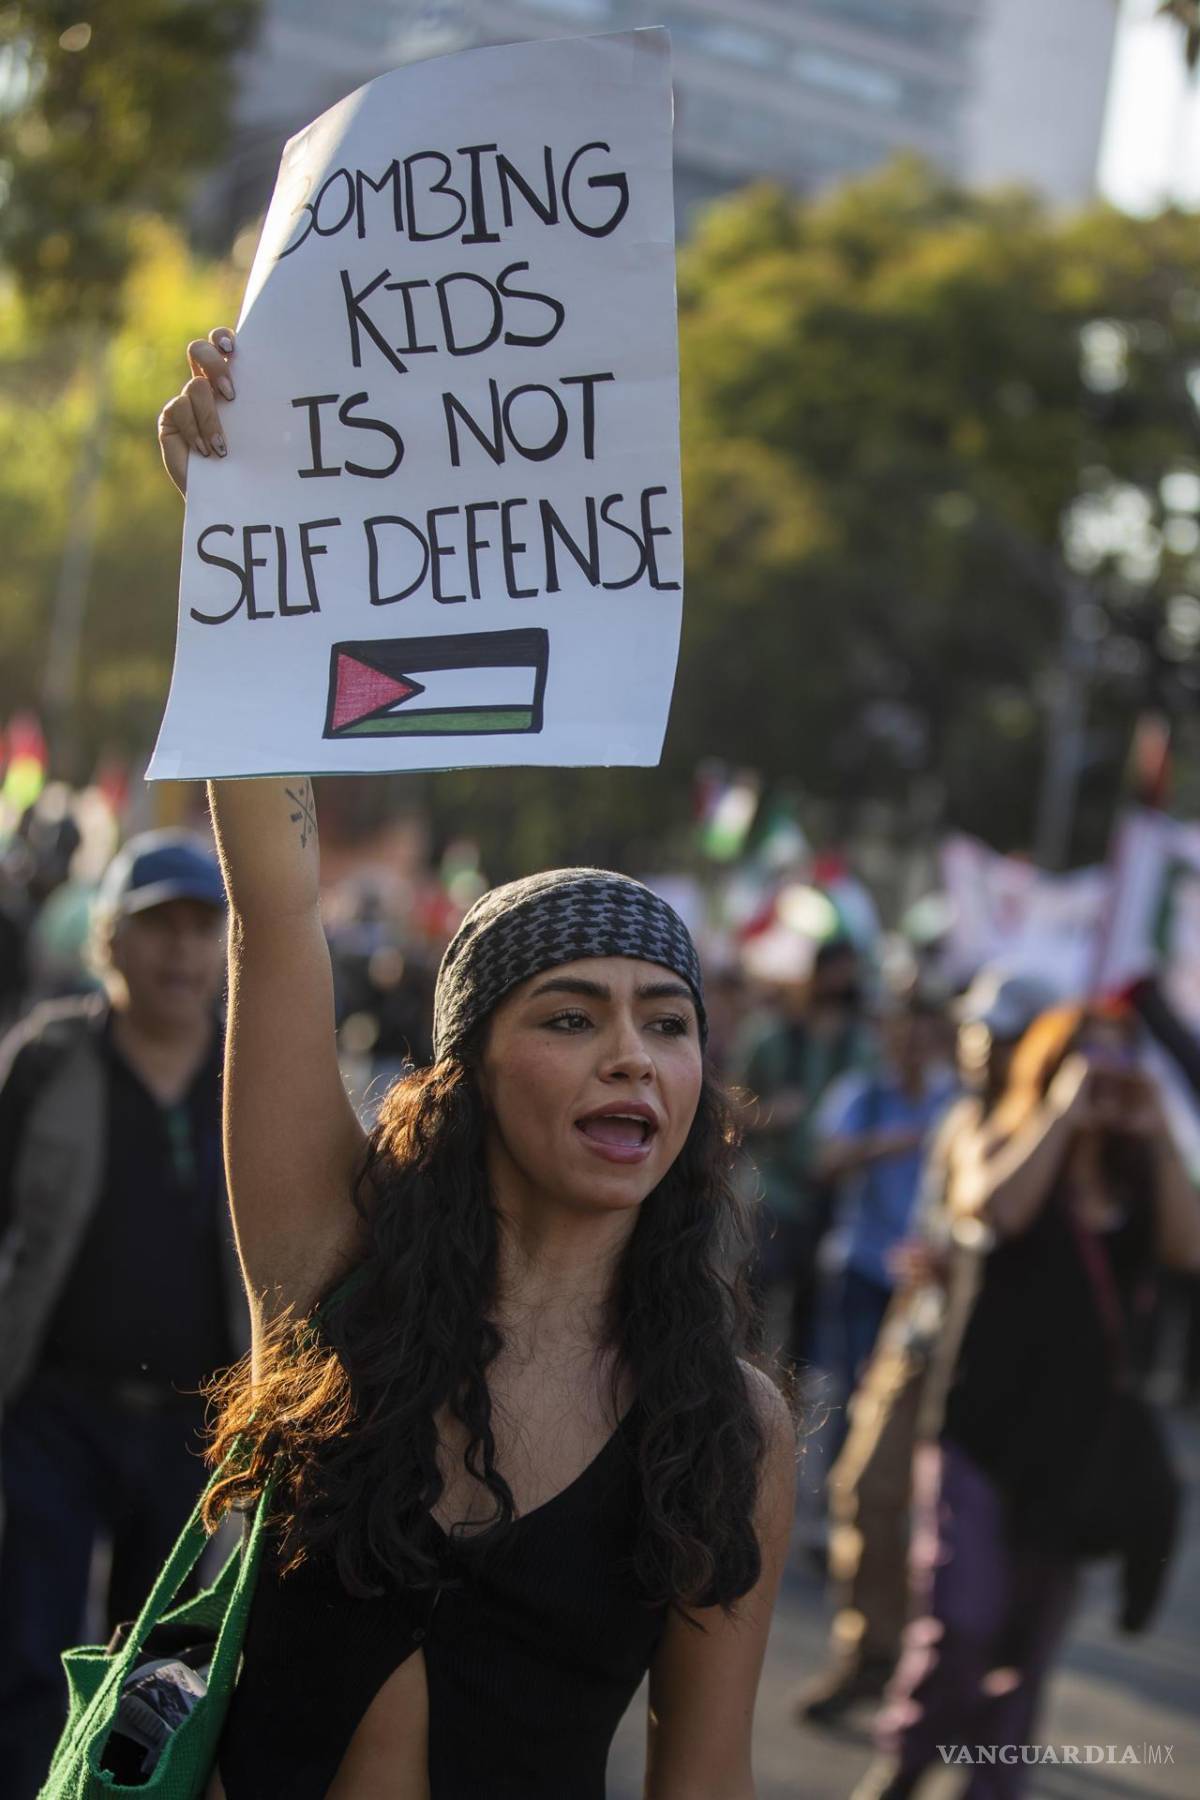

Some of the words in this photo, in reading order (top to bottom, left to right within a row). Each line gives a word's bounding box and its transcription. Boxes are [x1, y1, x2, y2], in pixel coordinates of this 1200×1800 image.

[339, 261, 565, 374] KIDS
[291, 391, 405, 478] IS
[442, 372, 614, 466] NOT
[190, 517, 342, 625] SELF
[363, 486, 681, 606] DEFENSE
